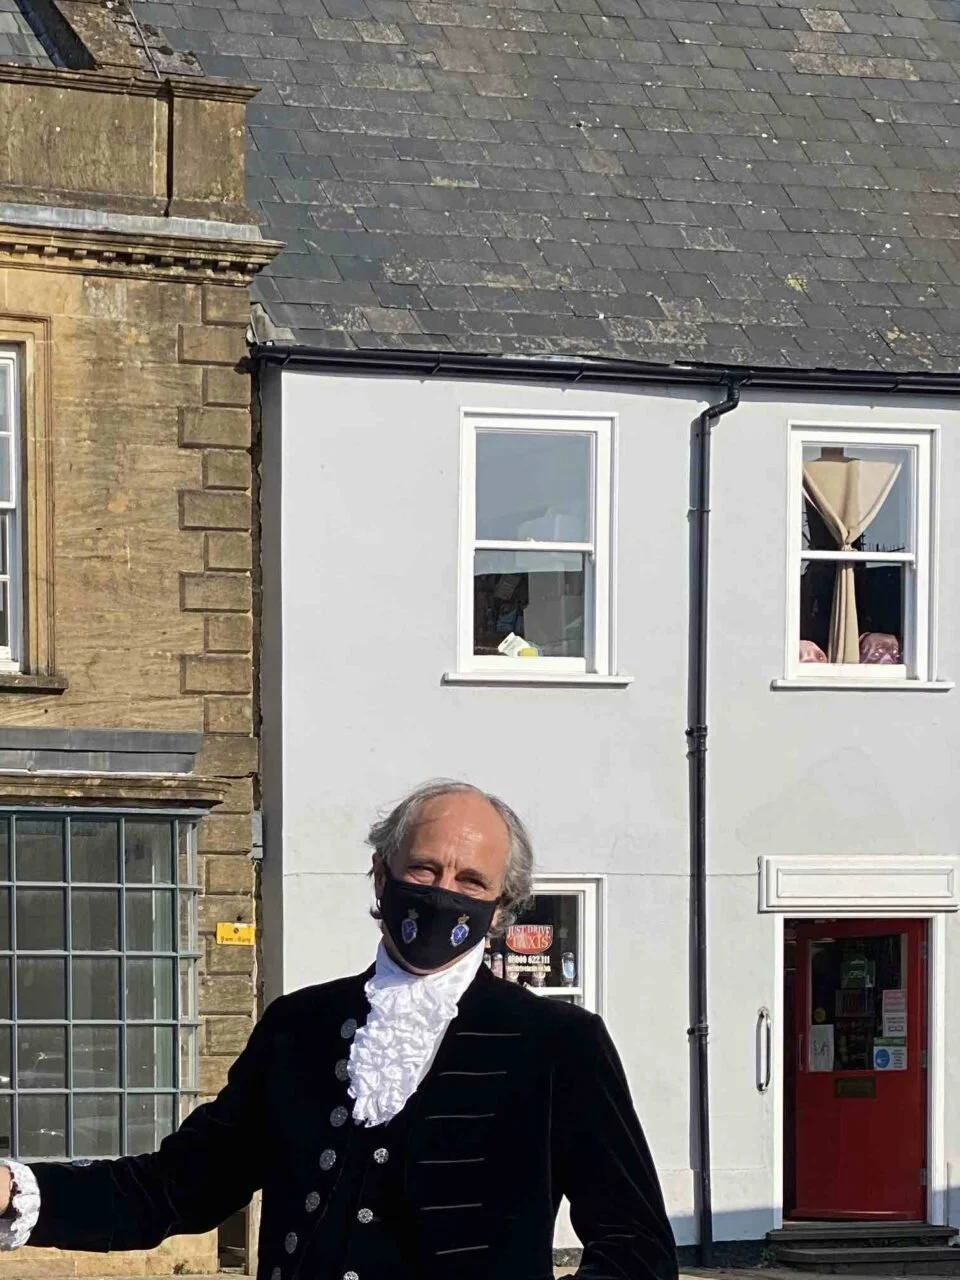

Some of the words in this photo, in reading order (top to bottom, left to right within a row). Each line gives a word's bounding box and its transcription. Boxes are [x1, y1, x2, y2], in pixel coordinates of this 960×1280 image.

[508, 925, 525, 938] JUST
[527, 925, 551, 939] DRIVE
[509, 934, 548, 949] TAXIS
